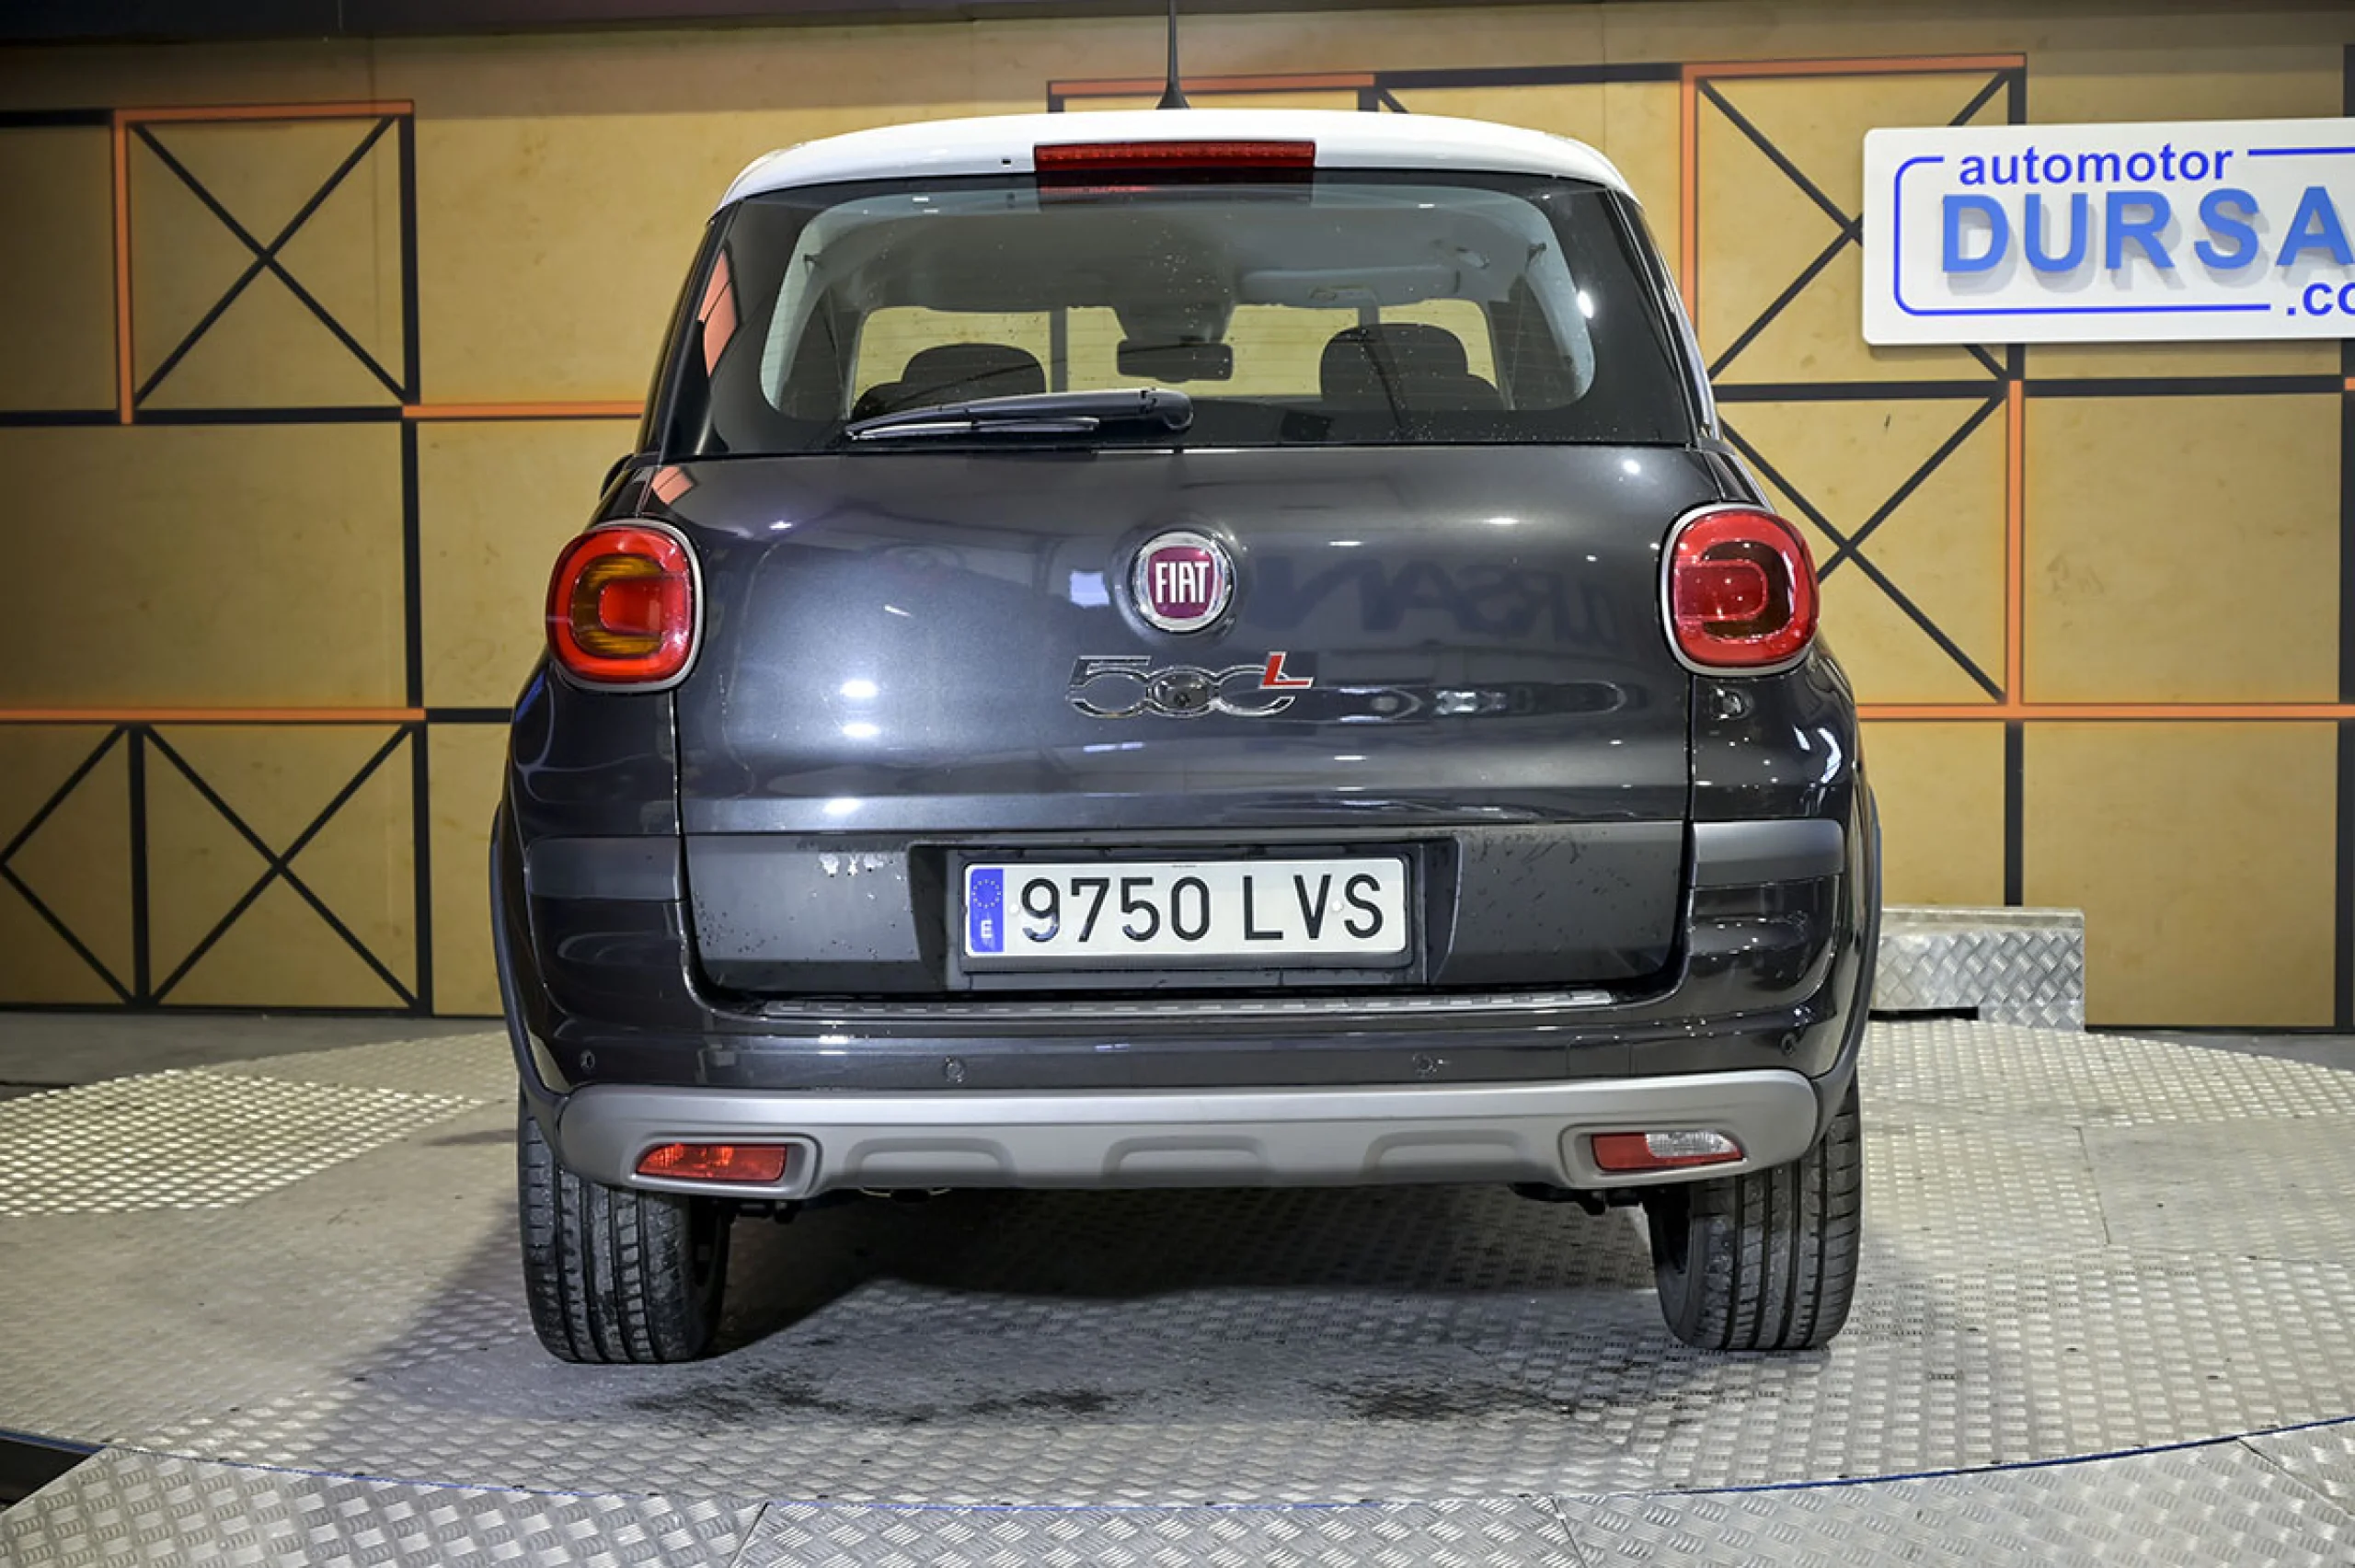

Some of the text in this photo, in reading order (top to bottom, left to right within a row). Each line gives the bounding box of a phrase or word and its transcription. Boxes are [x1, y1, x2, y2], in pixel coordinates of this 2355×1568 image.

[1959, 143, 2234, 186] automotor
[1942, 186, 2355, 273] DURSA
[1155, 561, 1210, 603] FIAT
[981, 920, 993, 937] E
[1020, 873, 1384, 943] 9750 LVS
